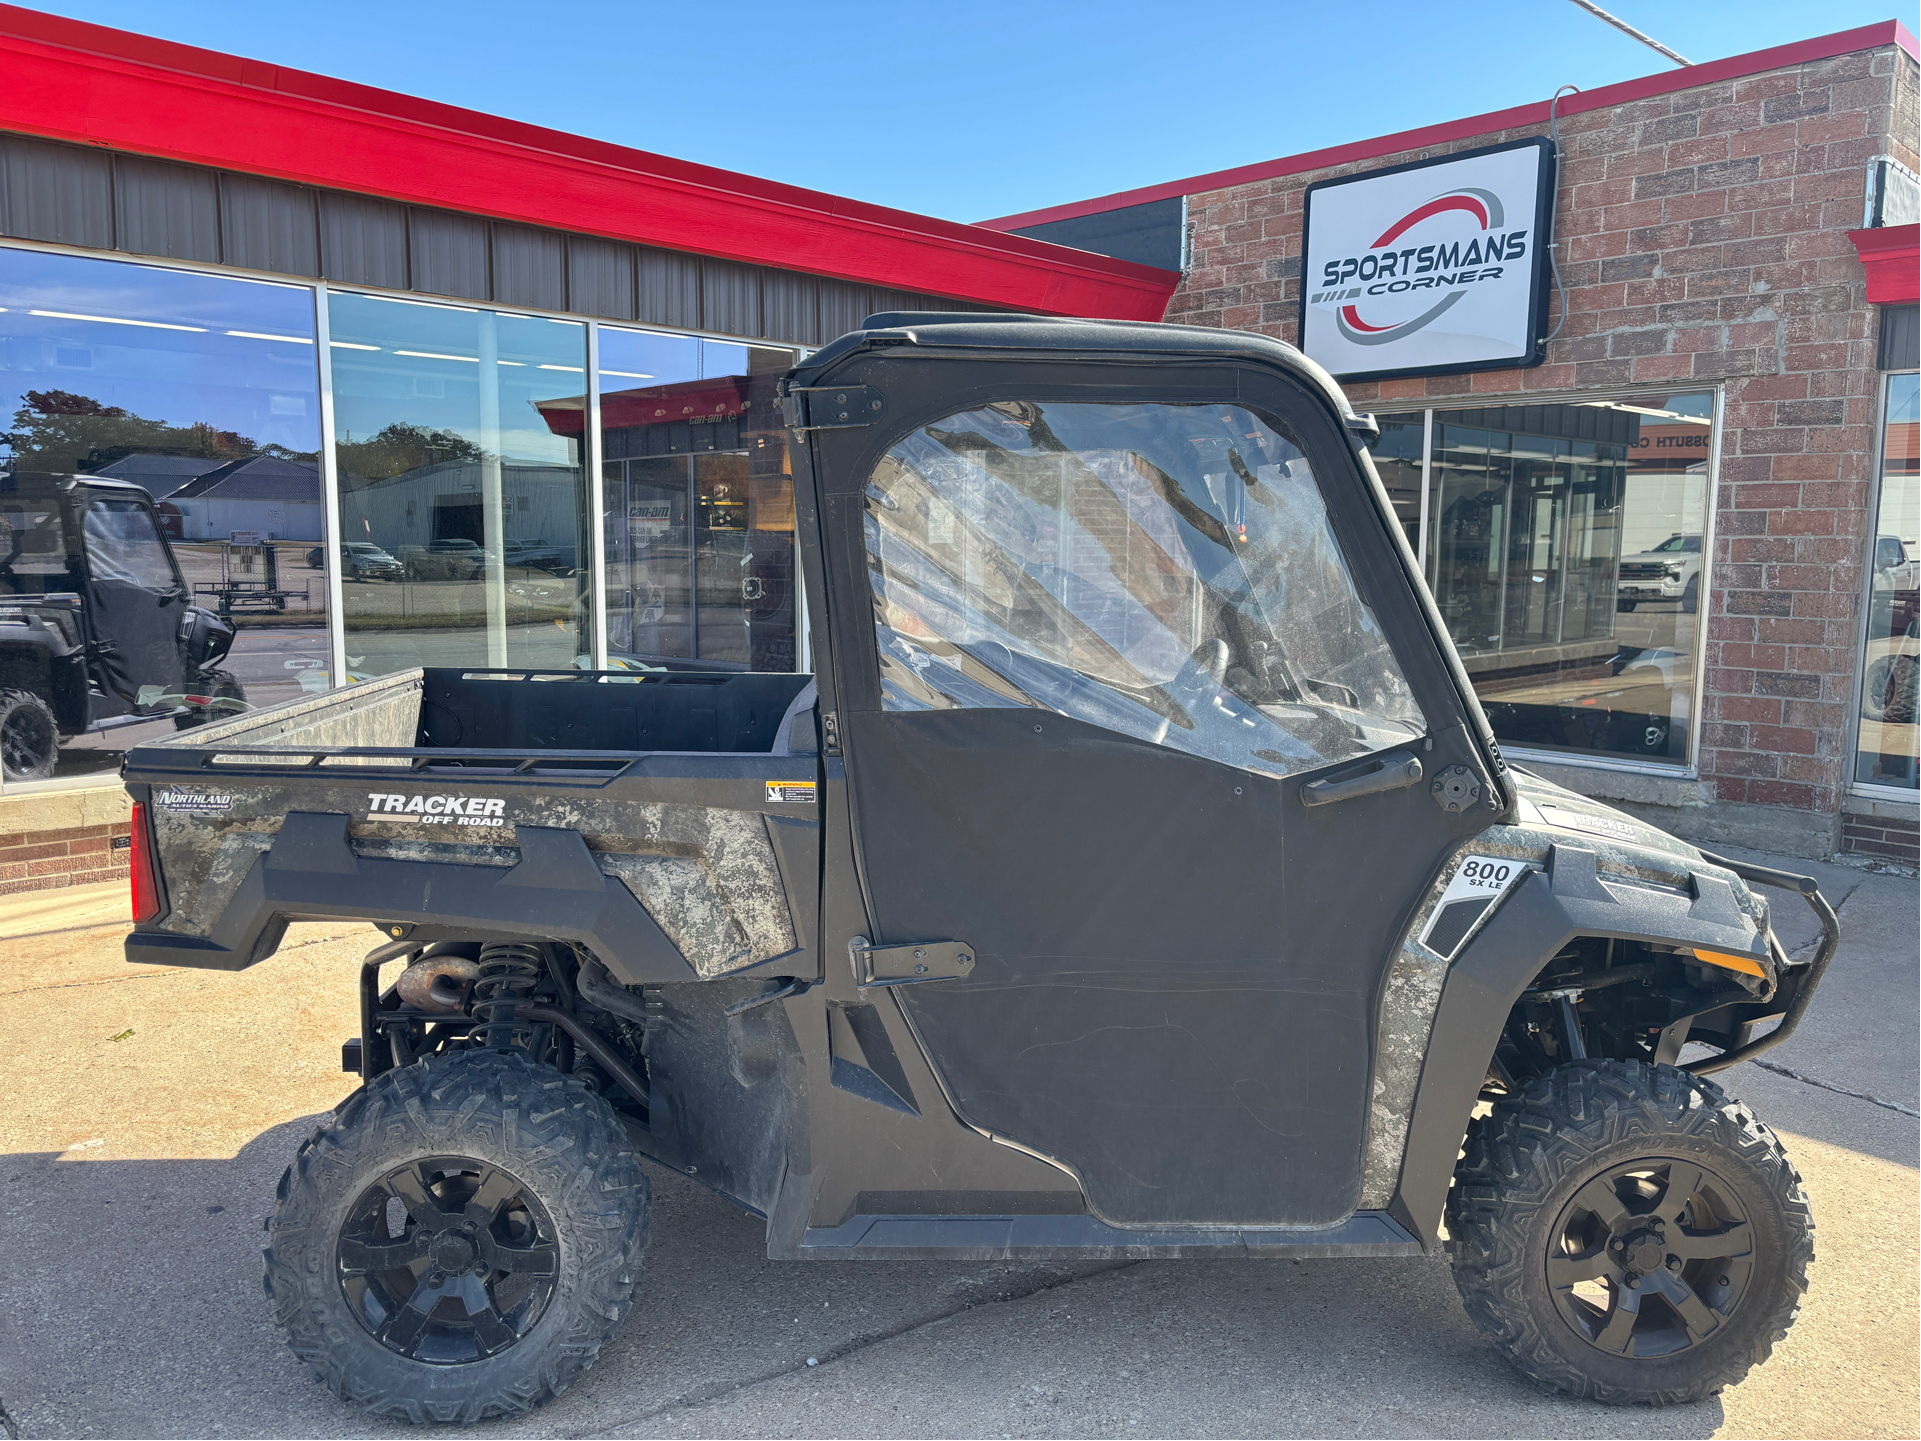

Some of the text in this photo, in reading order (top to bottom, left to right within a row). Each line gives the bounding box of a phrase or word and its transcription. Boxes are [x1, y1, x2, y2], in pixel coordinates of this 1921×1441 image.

[1322, 230, 1528, 287] SPORTSMANS
[1367, 267, 1504, 296] CORNER
[159, 792, 231, 804] NORTHLAND
[368, 793, 505, 816] TRACKER
[421, 815, 504, 827] OFF ROAD
[1573, 814, 1634, 834] TRACKER
[1601, 828, 1636, 840] OFF ROAD
[1463, 861, 1510, 881] 800
[1469, 879, 1503, 889] SX LE
